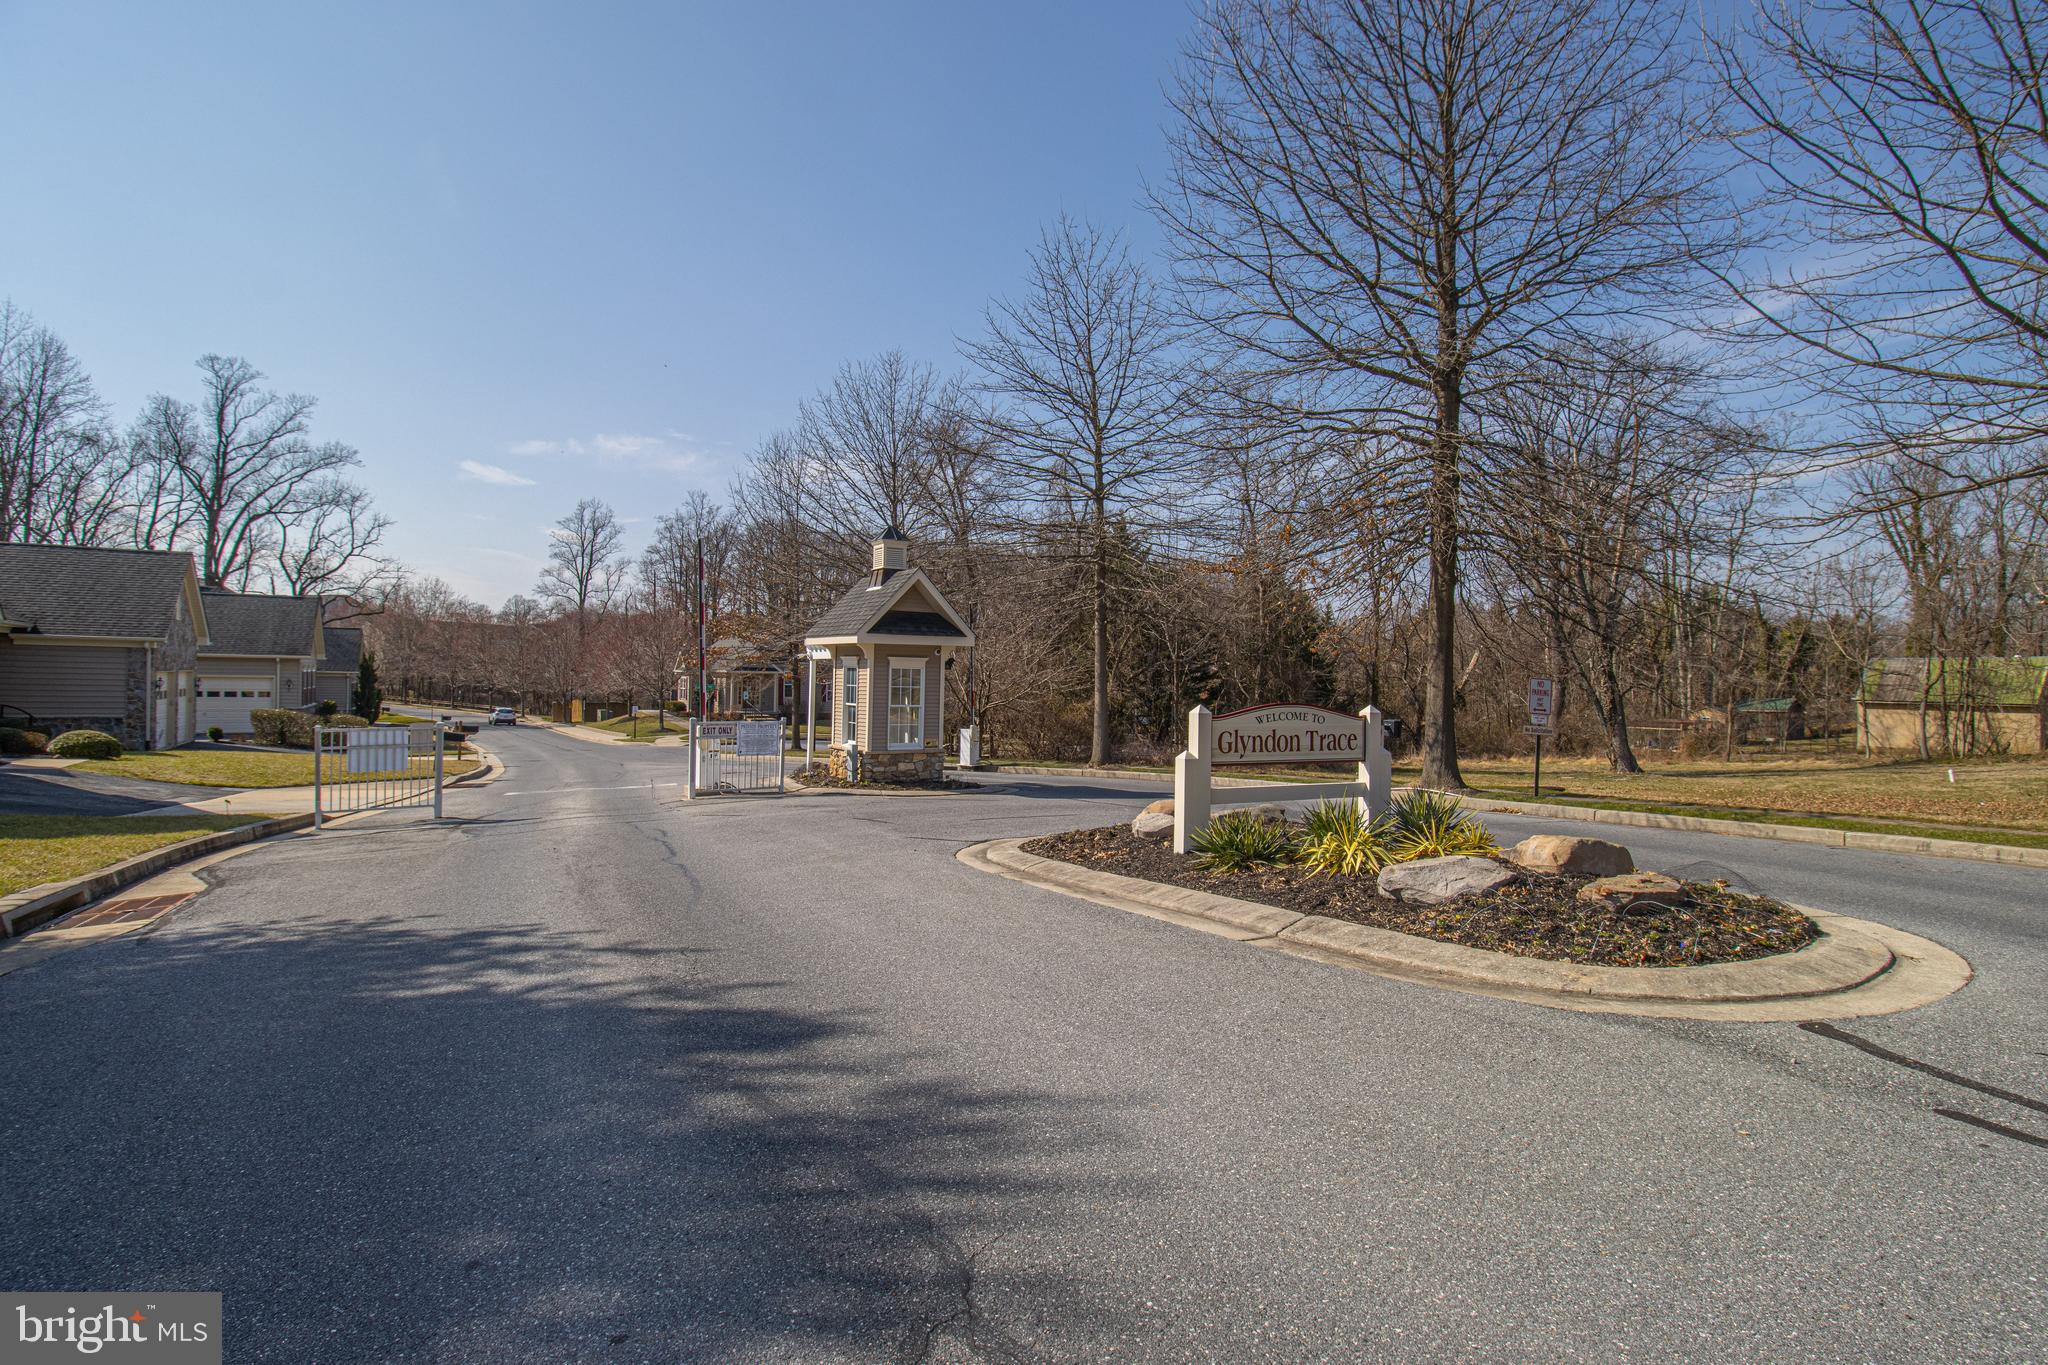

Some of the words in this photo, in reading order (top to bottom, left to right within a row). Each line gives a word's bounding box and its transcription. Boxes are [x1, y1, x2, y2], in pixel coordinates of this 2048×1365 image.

[1255, 711, 1309, 724] WELCOME
[1312, 713, 1326, 724] TO
[703, 727, 716, 735] EXIT
[718, 726, 733, 734] ONLY
[1217, 729, 1300, 759] Glyndon
[1305, 730, 1358, 752] Trace
